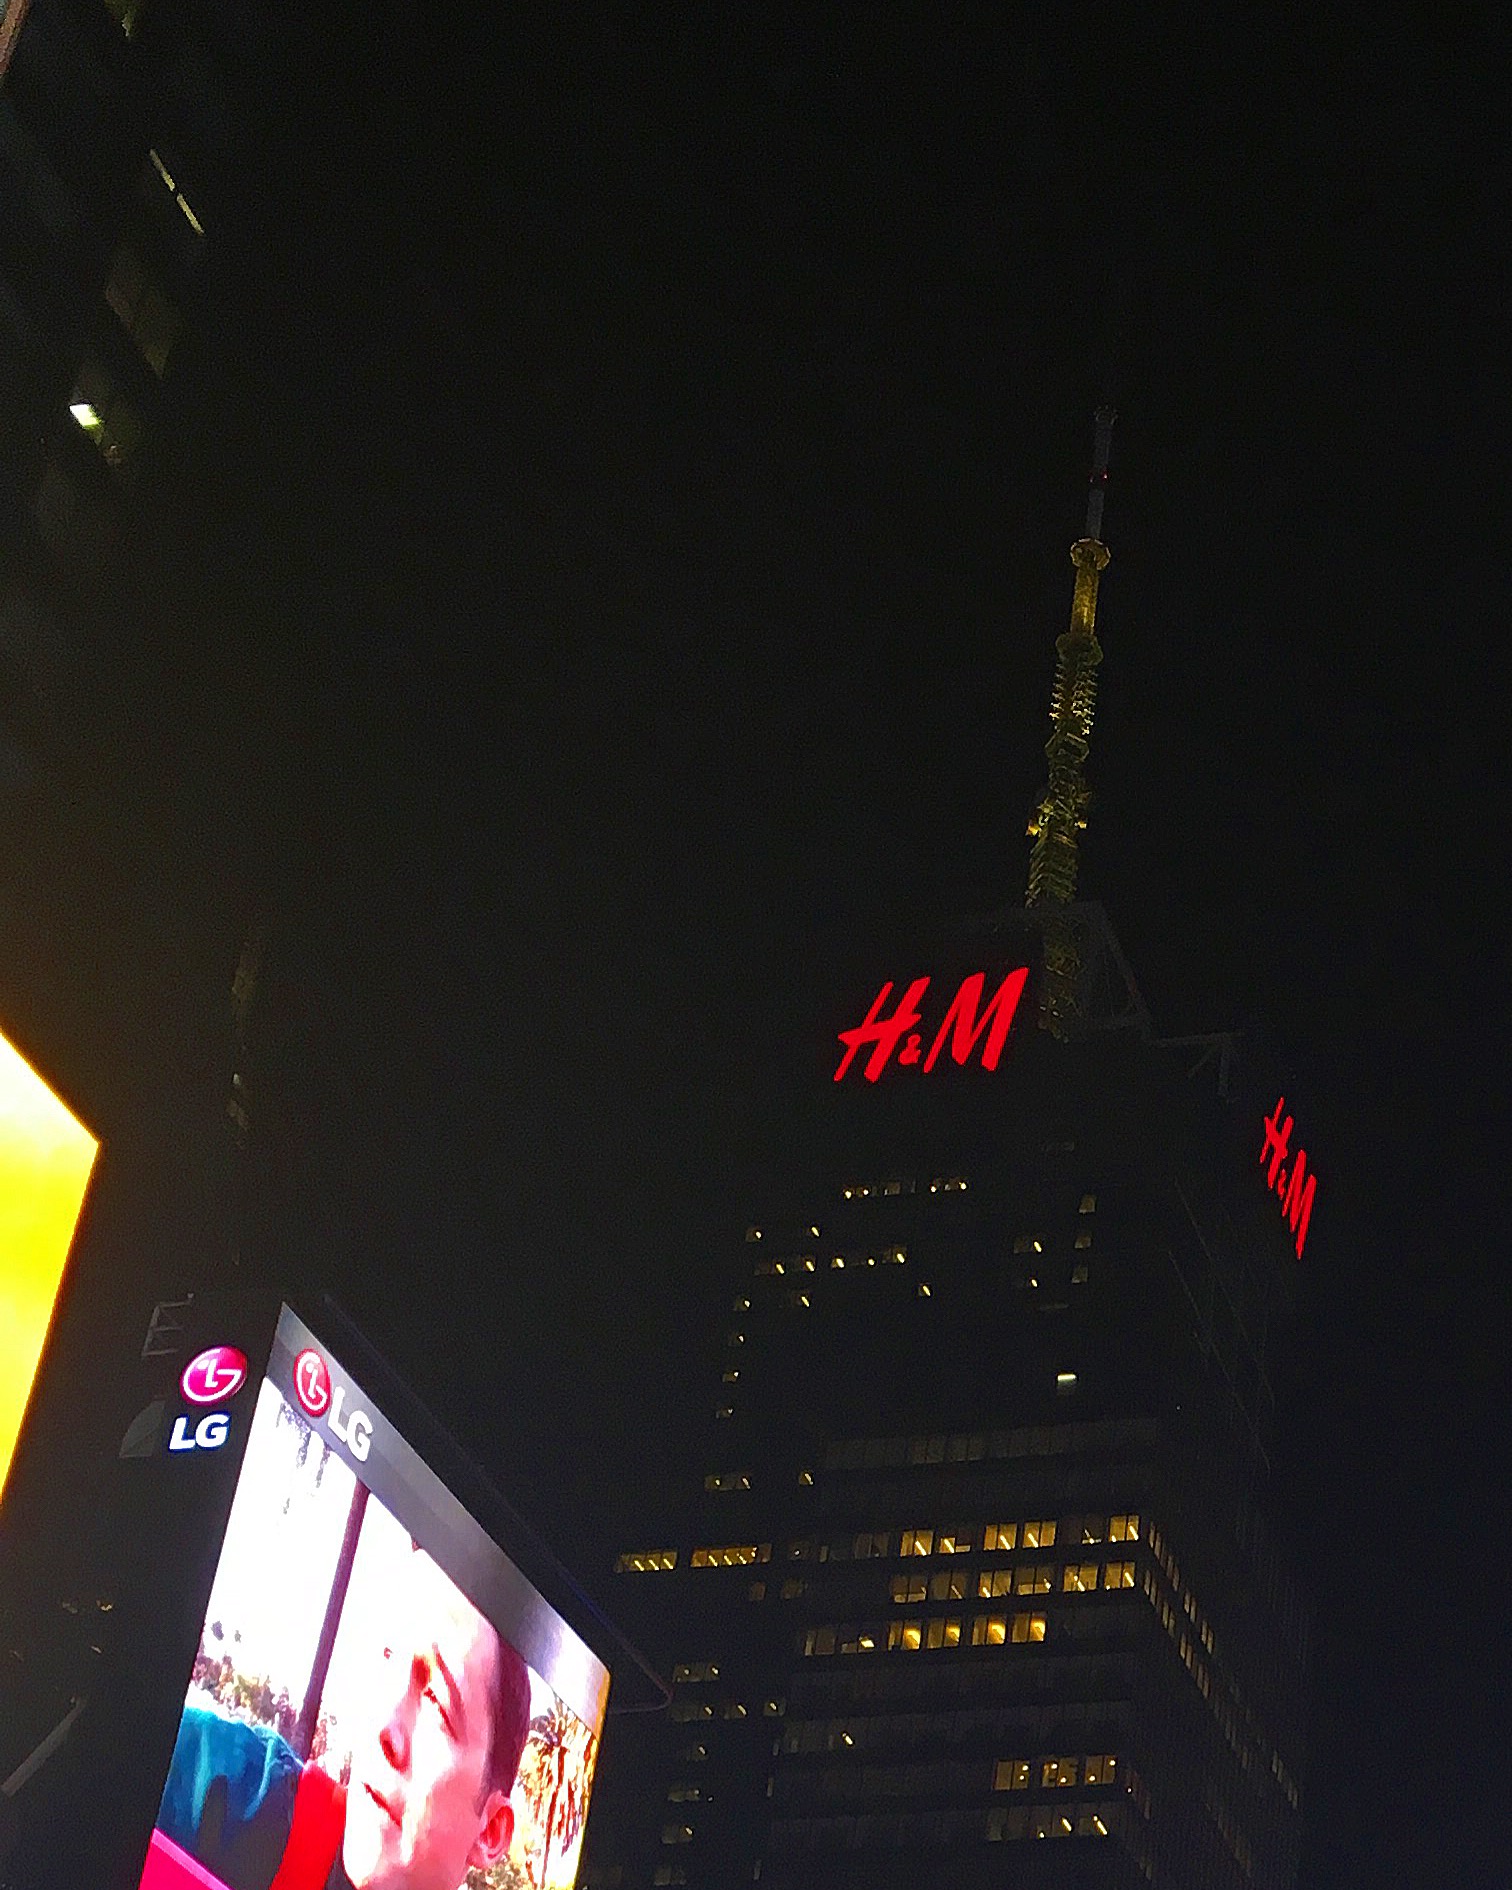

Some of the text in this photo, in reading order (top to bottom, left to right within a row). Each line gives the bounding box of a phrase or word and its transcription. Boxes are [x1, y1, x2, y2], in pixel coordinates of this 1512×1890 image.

[833, 967, 1029, 1083] H&M
[1259, 1096, 1317, 1261] H&M
[169, 1413, 231, 1450] LG
[327, 1386, 374, 1463] LG
